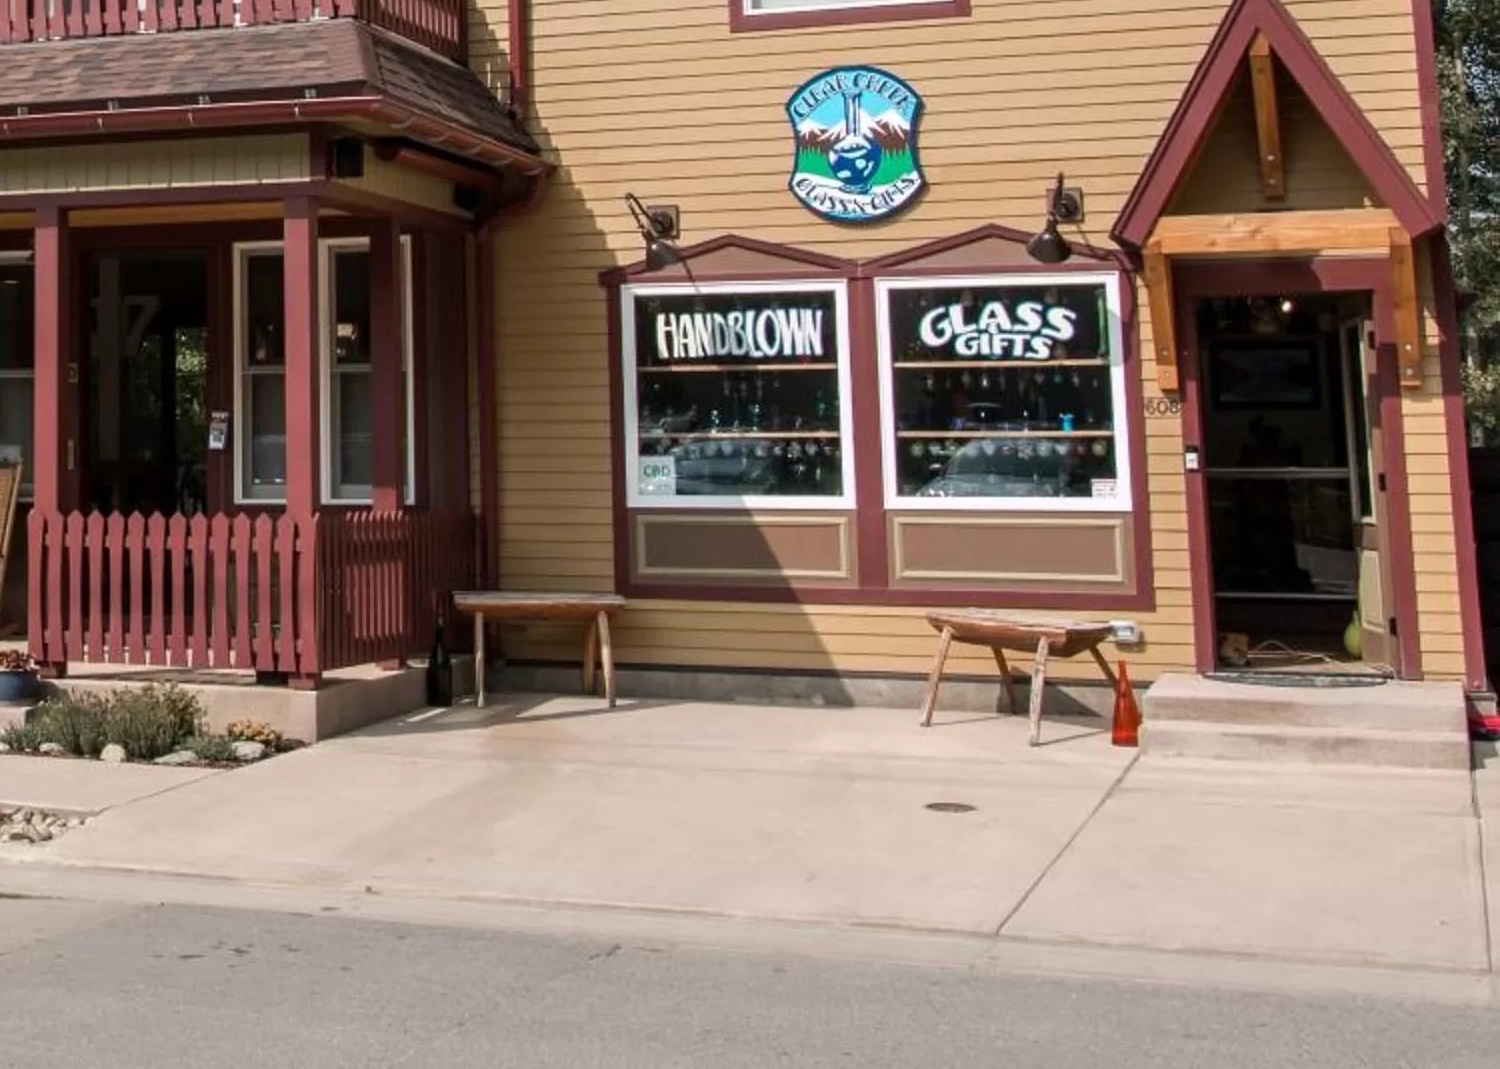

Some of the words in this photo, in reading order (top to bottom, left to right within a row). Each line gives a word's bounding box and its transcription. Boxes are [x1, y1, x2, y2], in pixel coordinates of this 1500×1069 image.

[792, 74, 847, 119] CLEAR
[852, 71, 914, 115] CREEK
[656, 308, 824, 359] HANDBLOWN
[920, 300, 1077, 347] GLASS
[955, 332, 1053, 360] GIFTS
